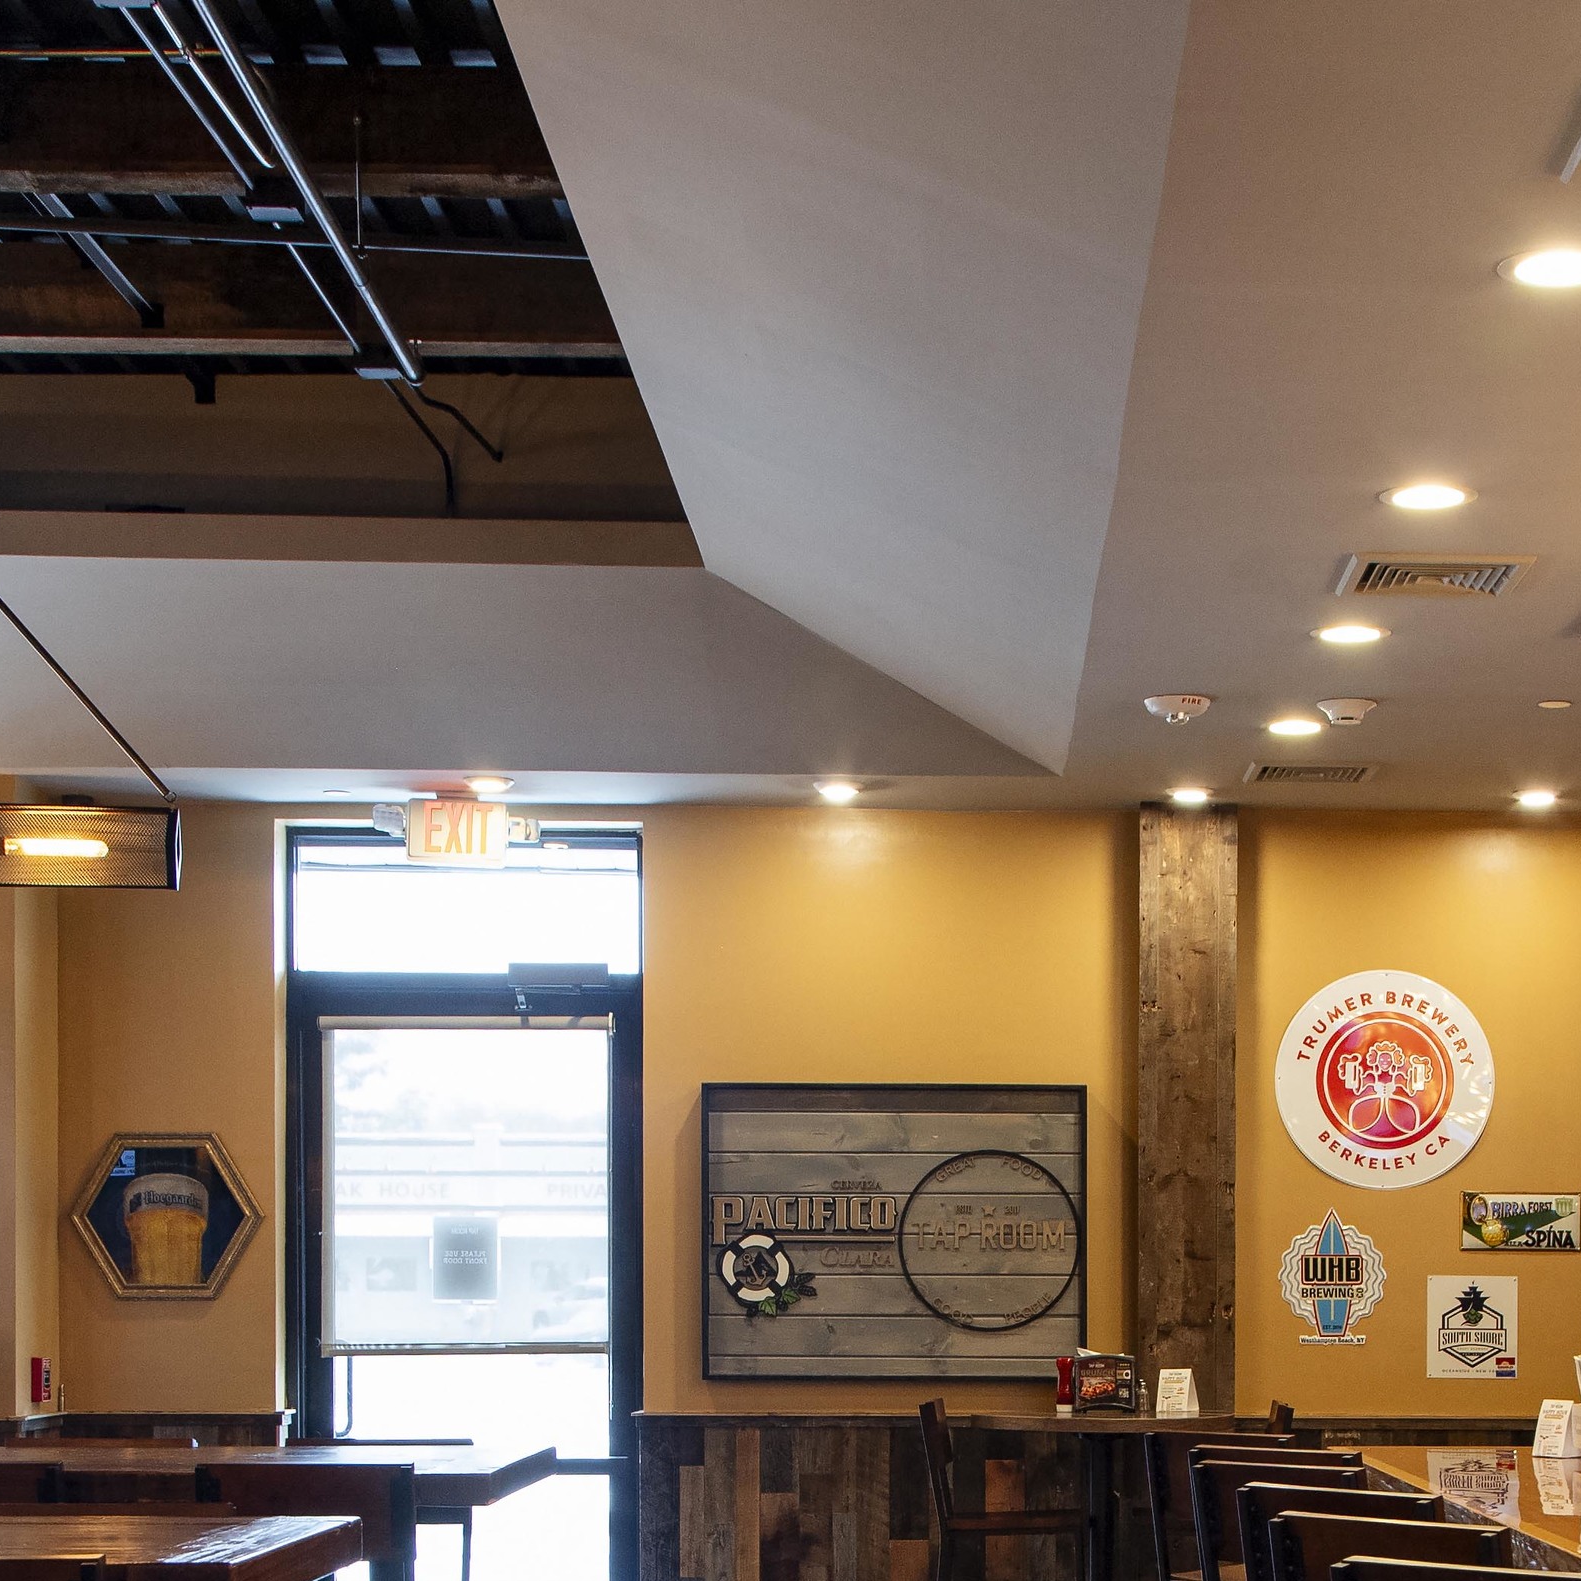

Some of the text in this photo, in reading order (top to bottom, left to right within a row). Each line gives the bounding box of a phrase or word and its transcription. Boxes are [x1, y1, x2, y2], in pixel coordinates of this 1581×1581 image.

[1181, 697, 1202, 706] FIRE
[423, 800, 494, 855] EXIT
[1296, 990, 1476, 1067] TRUMER BREWERY
[1317, 1129, 1451, 1171] BERKELEY CA
[935, 1155, 1045, 1183] GREAT FOOD
[379, 1182, 450, 1199] HOUSE
[830, 1179, 883, 1191] CERVEZA
[711, 1195, 898, 1246] PACIFICO
[1490, 1201, 1553, 1218] BIRRA FORST
[911, 1218, 1065, 1251] TAP ROOM
[1304, 1257, 1361, 1282] WHB
[1301, 1287, 1354, 1299] BREWING
[933, 1291, 1054, 1326] GOOD PEOPLE
[1442, 1331, 1503, 1347] SOUTH SHORE
